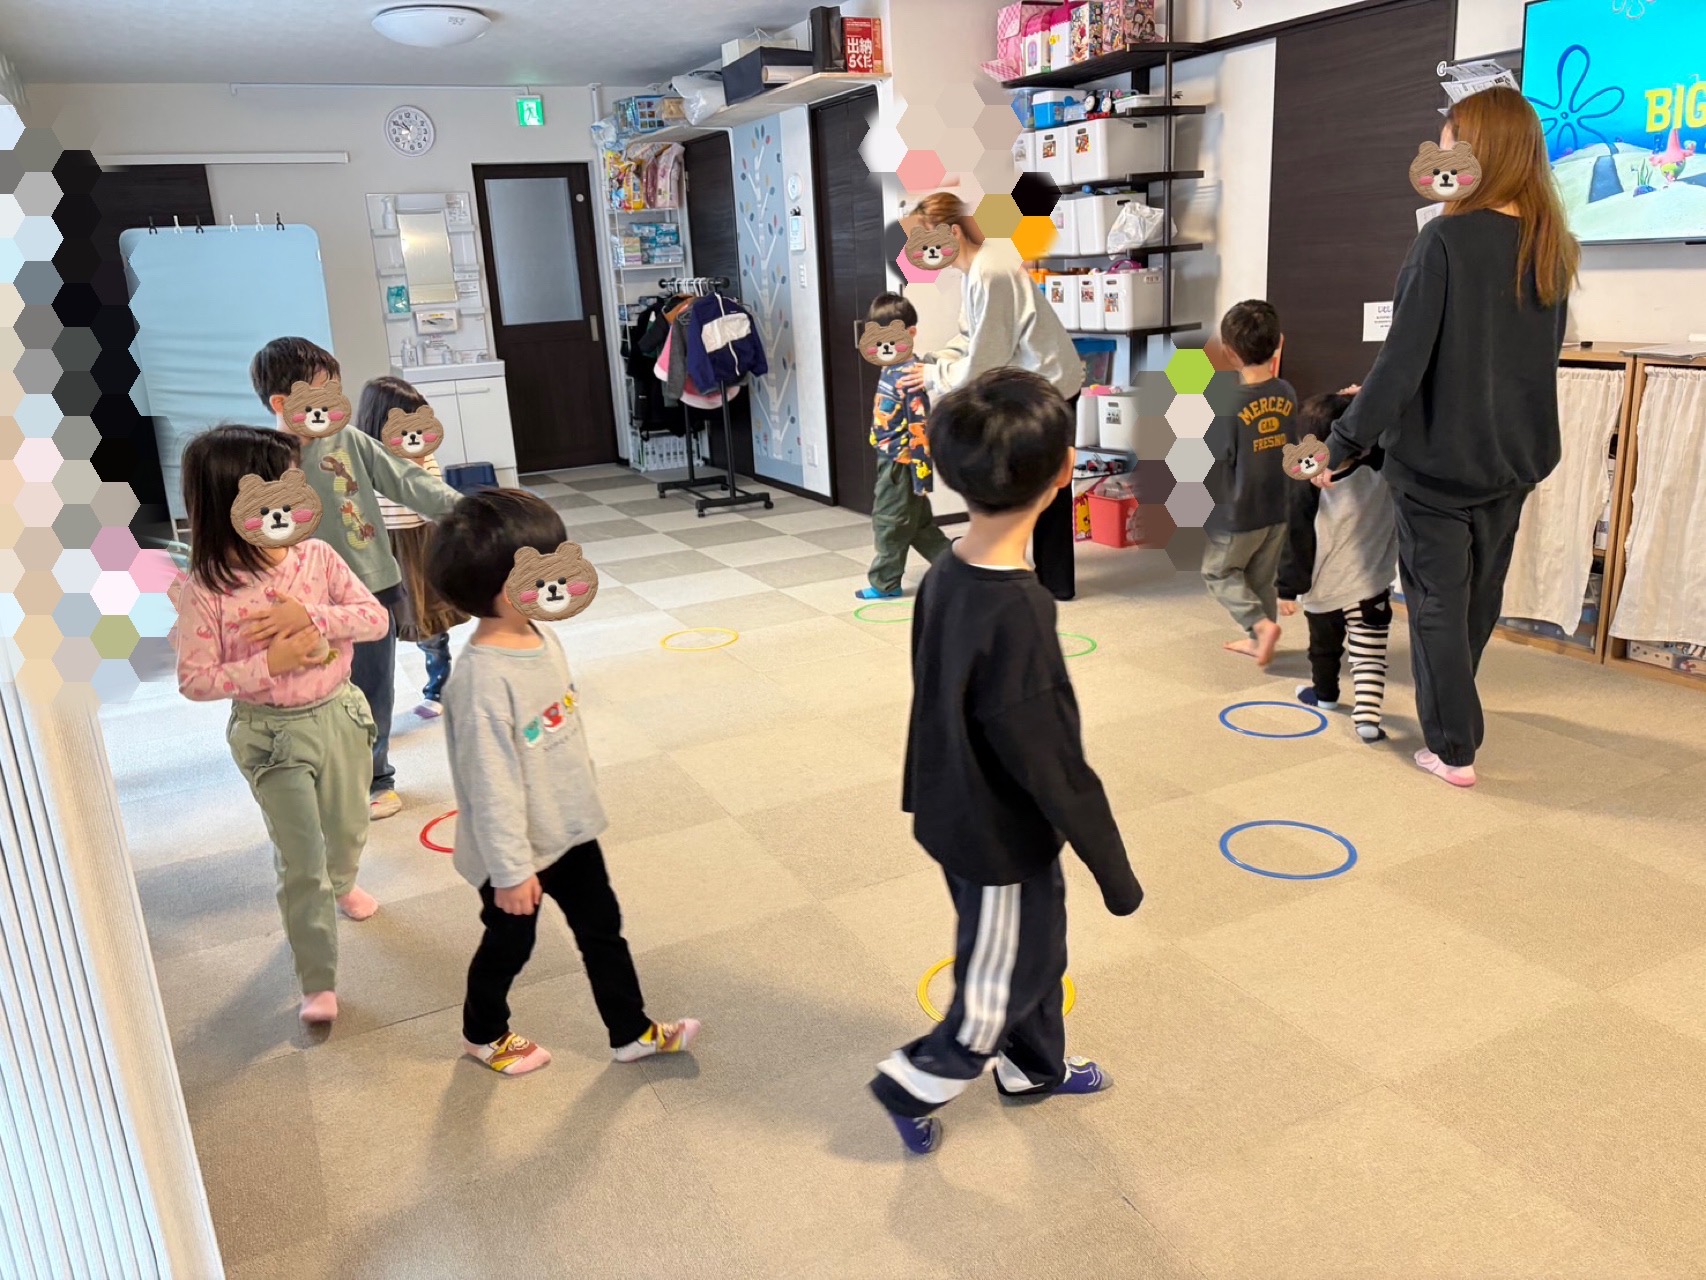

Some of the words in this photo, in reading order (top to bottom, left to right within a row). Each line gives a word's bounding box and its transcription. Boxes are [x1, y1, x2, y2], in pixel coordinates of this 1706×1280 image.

[847, 37, 872, 54] 出納
[1645, 81, 1706, 133] BIG
[1237, 396, 1293, 426] MERCED
